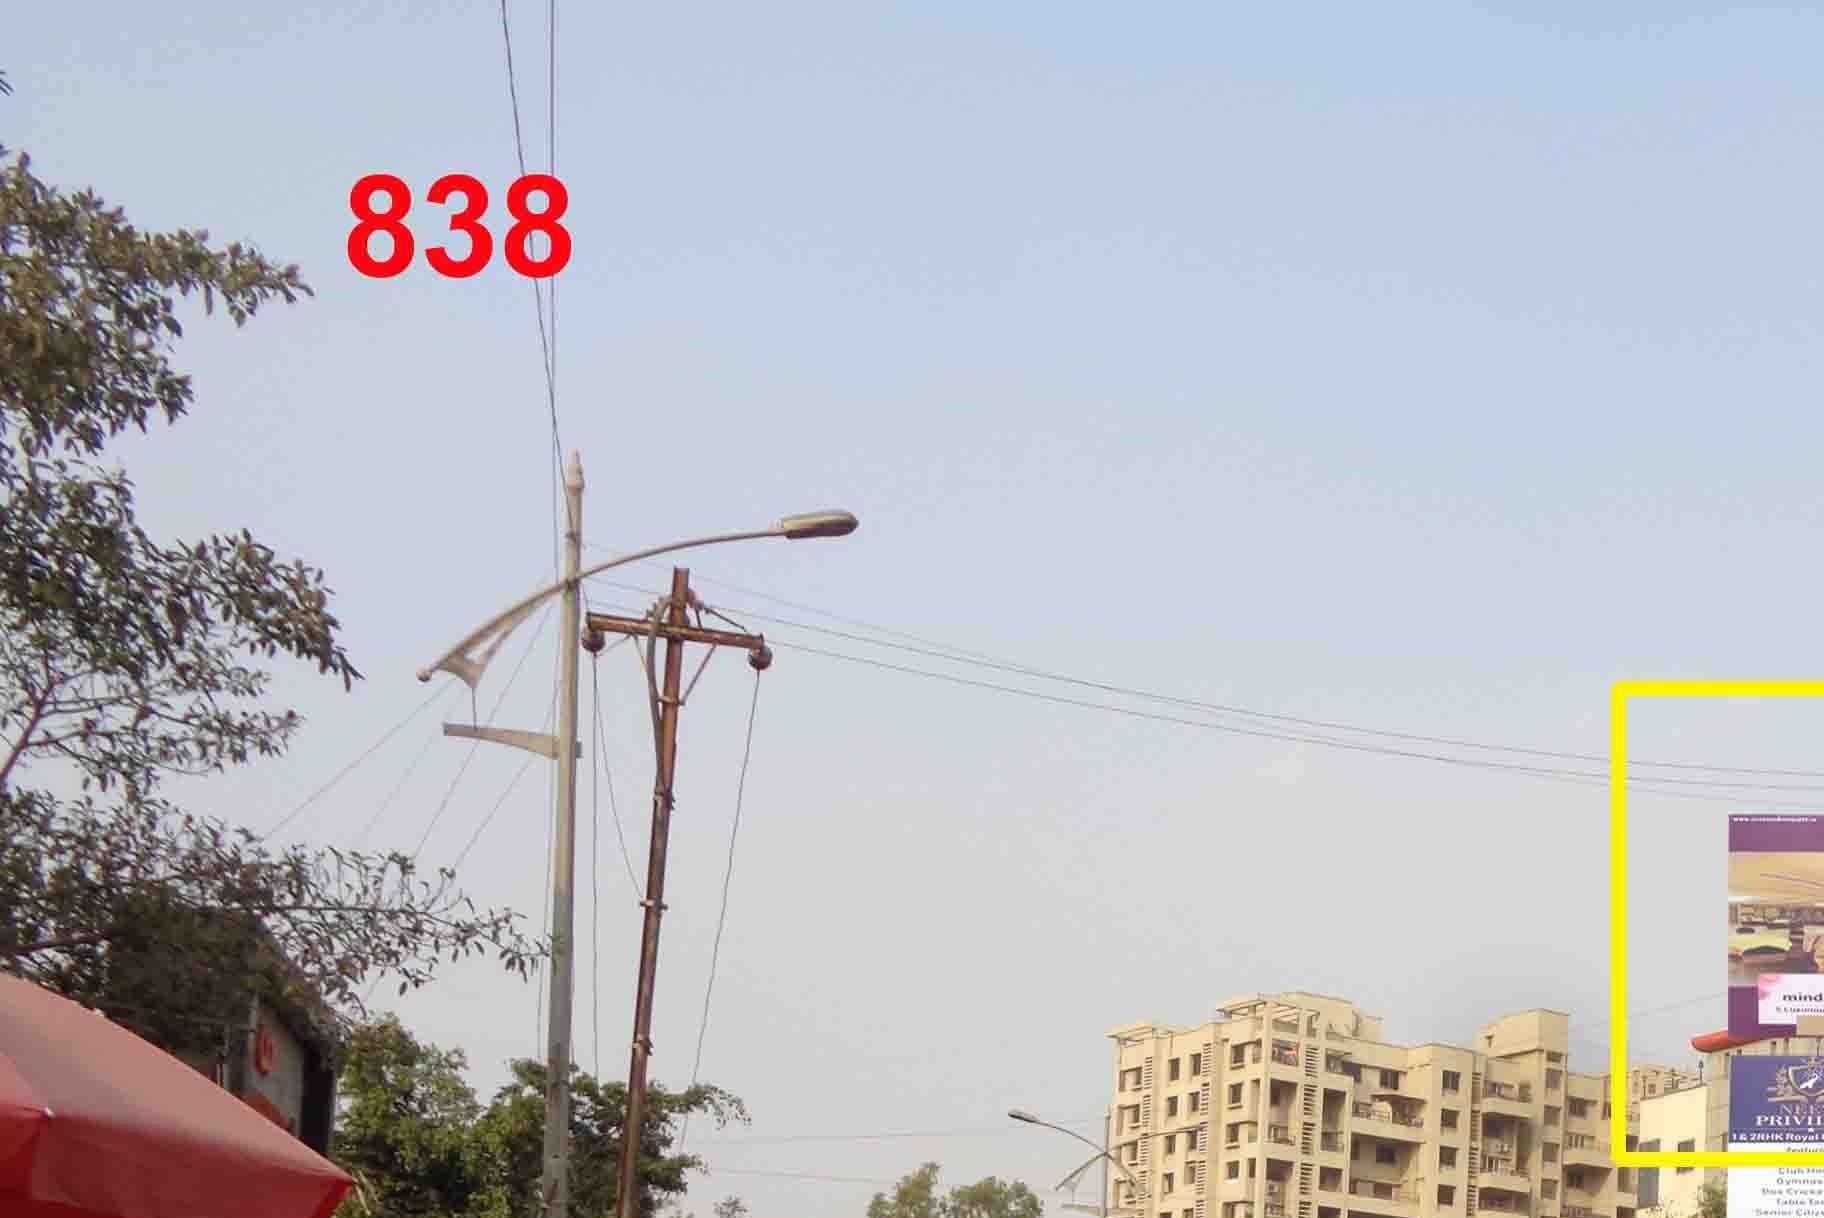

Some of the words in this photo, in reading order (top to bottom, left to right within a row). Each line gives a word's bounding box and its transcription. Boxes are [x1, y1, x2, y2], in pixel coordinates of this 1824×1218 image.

[1782, 993, 1822, 1002] mind
[1786, 1133, 1819, 1143] Royal
[1755, 1208, 1793, 1216] Senior
